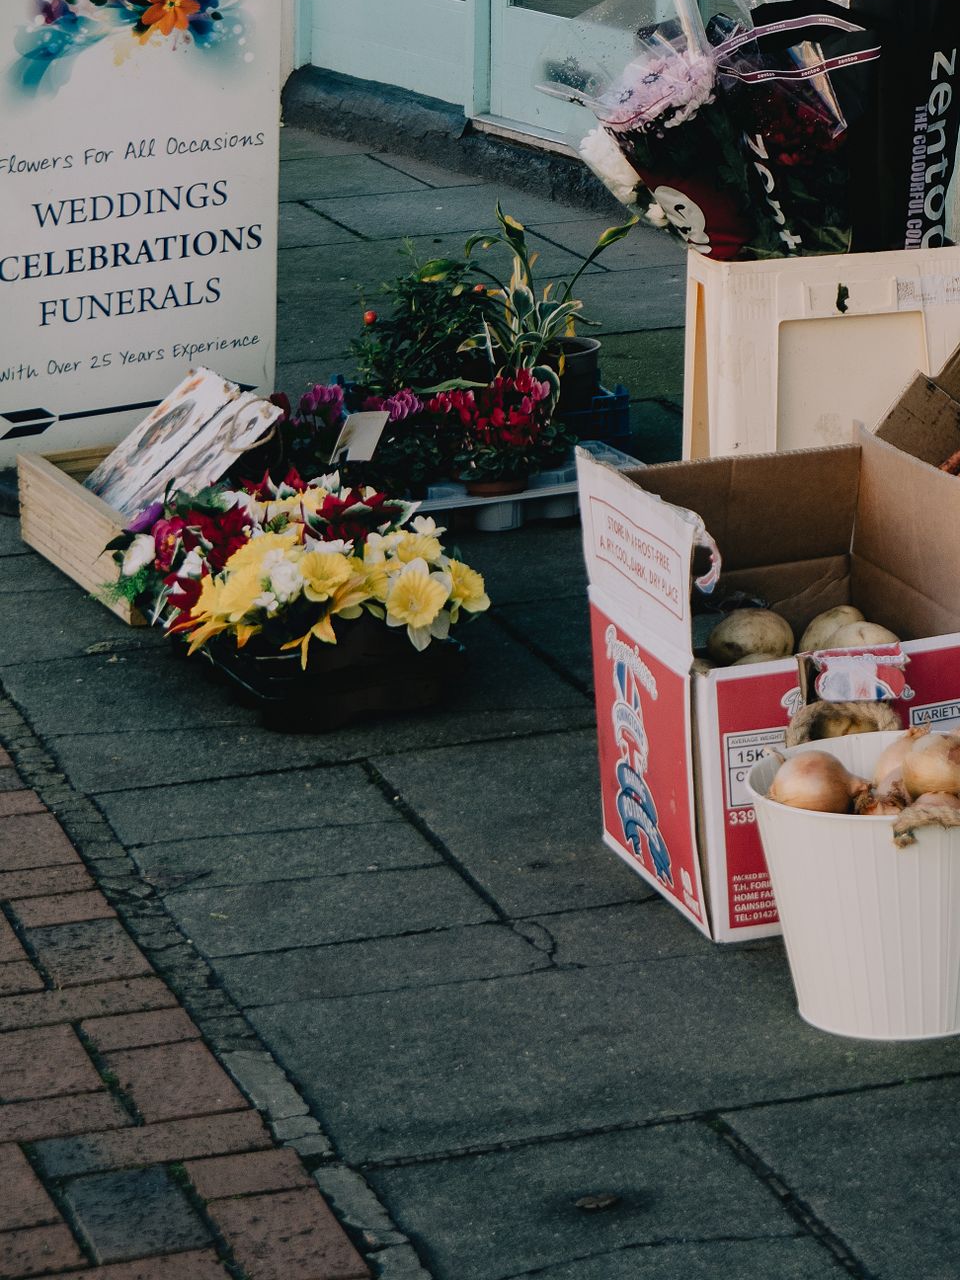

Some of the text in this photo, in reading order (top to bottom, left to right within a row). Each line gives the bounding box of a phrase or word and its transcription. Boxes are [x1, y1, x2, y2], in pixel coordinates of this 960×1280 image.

[914, 104, 929, 133] THE
[84, 147, 114, 166] For
[123, 138, 156, 161] All
[166, 130, 266, 156] Occasions
[907, 134, 927, 217] COLOURFUL
[31, 179, 228, 228] WEDDINGS
[0, 223, 263, 283] CELEBRATIONS
[38, 276, 222, 327] FUNERALS
[0, 333, 260, 384] With Over 25 Years Experience
[731, 733, 783, 746] AVERAGE WEIGHT
[737, 748, 766, 763] 15K
[734, 891, 759, 902] HOME
[735, 913, 752, 922] TEL:
